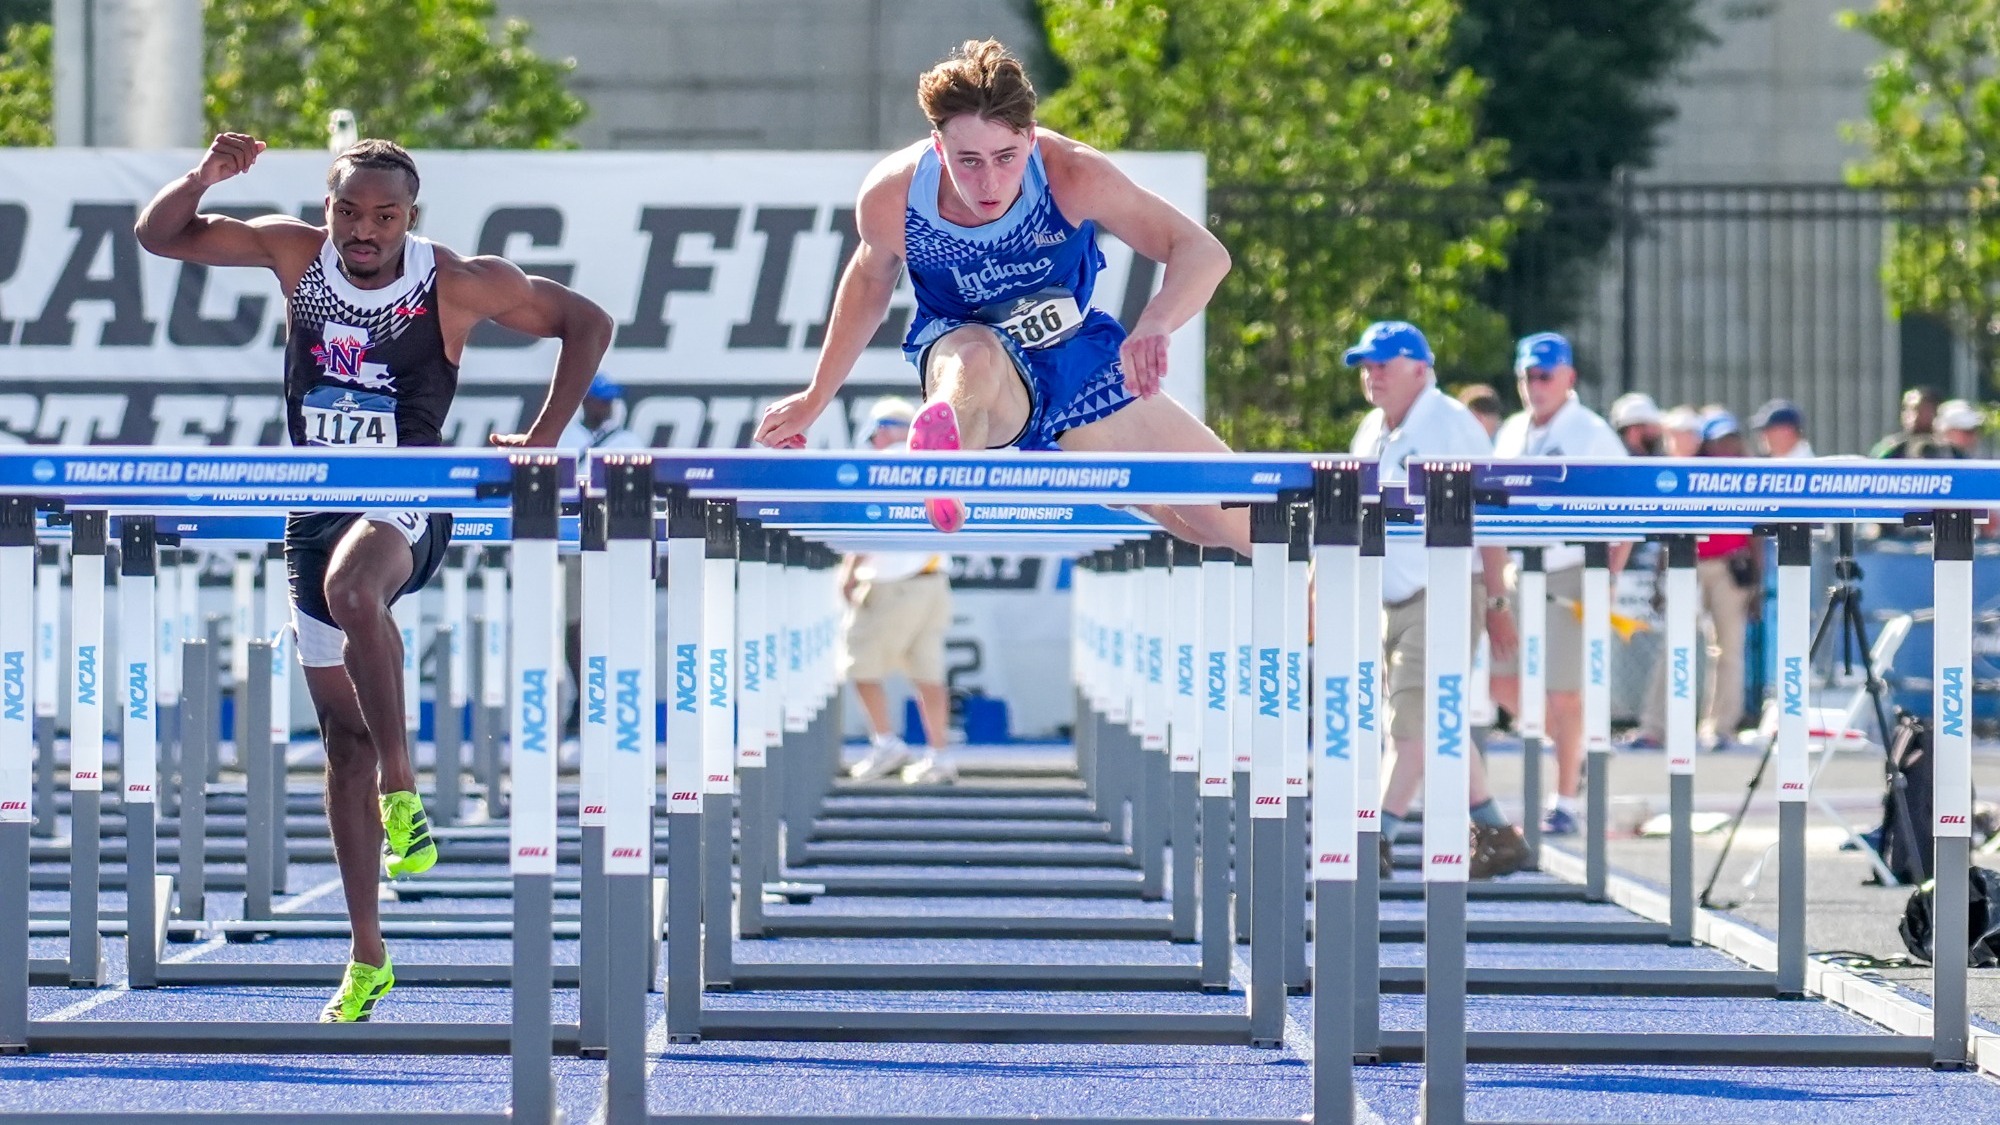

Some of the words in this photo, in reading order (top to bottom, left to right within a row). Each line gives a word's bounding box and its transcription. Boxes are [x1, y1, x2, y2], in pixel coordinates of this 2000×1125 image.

[1031, 229, 1067, 246] VALLEY
[949, 257, 1052, 292] Indiana
[328, 342, 361, 377] N
[316, 413, 386, 444] 1174
[64, 461, 118, 482] TRACK
[121, 462, 135, 482] &
[136, 462, 182, 482] FIELD
[186, 462, 328, 483] CHAMPIONSHIPS
[685, 468, 714, 480] GILL
[868, 466, 923, 485] TRACK
[925, 467, 939, 486] &
[940, 467, 985, 486] FIELD
[989, 467, 1131, 488] CHAMPIONSHIPS
[1252, 472, 1282, 484] GILL
[1688, 473, 1742, 492] TRACK
[1744, 474, 1757, 493] &
[1759, 474, 1805, 493] FIELD
[1809, 474, 1952, 495] CHAMPIONSHIPS
[759, 508, 780, 516] GILL
[888, 506, 926, 519] TRACK
[973, 506, 1074, 520] CHAMPIONSHIPS
[177, 523, 198, 532] GILL
[4, 651, 24, 721] NCAA
[78, 645, 96, 705] NCAA
[676, 644, 697, 713] NCAA
[710, 648, 727, 708] NCAA
[1208, 652, 1226, 711] NCAA
[1259, 648, 1280, 718] NCAA
[1287, 652, 1300, 711] NCAA
[130, 662, 148, 720] NCAA
[589, 656, 607, 724] NCAA
[1358, 661, 1374, 731] NCAA
[1784, 656, 1802, 717] NCAA
[522, 669, 547, 753] NCAA
[616, 669, 641, 753] NCAA
[1943, 667, 1963, 737] NCAA
[1325, 676, 1349, 760] NCAA
[1437, 674, 1462, 758] NCAA
[128, 784, 151, 792] GILL
[672, 792, 698, 801] GILL
[1782, 782, 1804, 790] GILL
[0, 801, 27, 810] GILL
[1255, 796, 1281, 805] GILL
[1357, 810, 1376, 818] ILL
[1940, 815, 1966, 824] GILL
[518, 847, 548, 857] GILL
[612, 848, 642, 858] GILL
[1320, 853, 1350, 864] GILL
[1432, 855, 1462, 864] GILL
